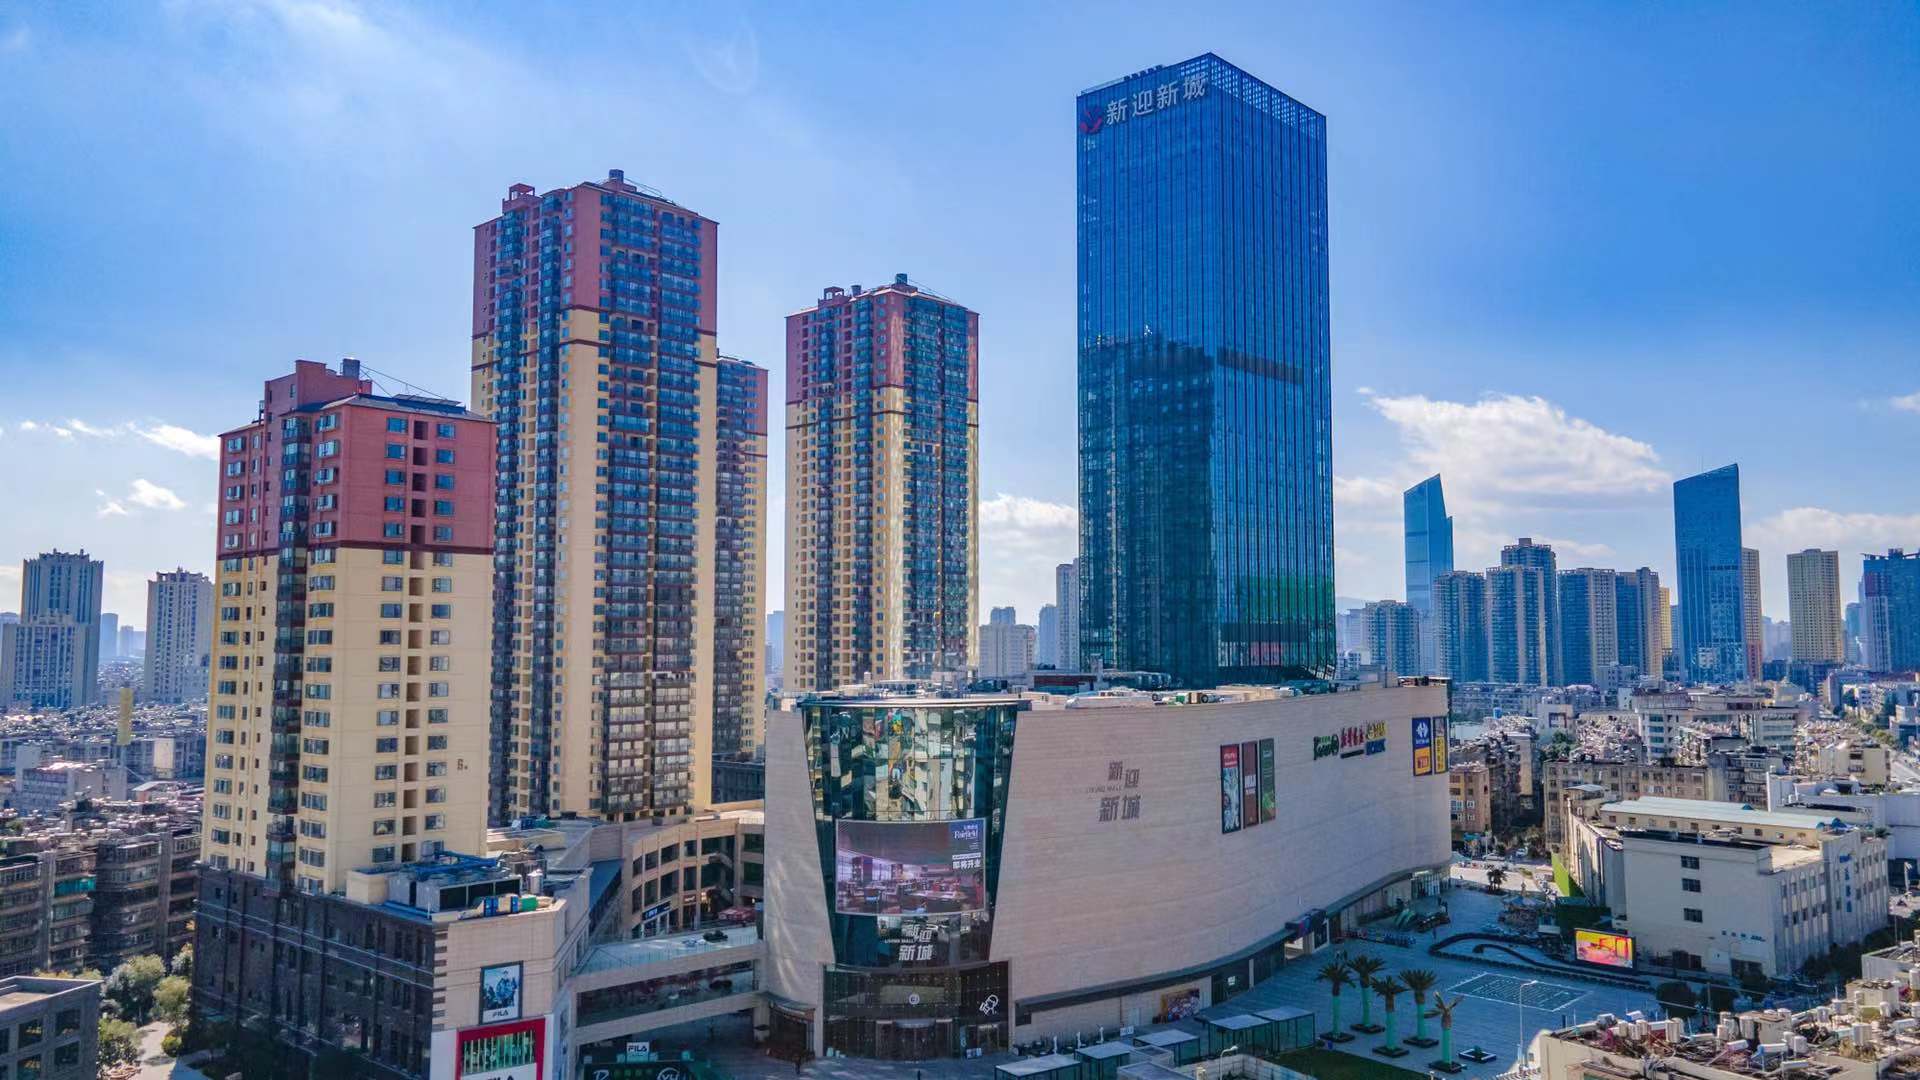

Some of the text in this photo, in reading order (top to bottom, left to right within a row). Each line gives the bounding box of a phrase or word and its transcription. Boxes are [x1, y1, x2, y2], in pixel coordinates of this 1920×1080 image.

[1106, 73, 1206, 126] 新迎新城
[1099, 795, 1141, 821] 新城
[899, 944, 934, 961] 新城
[492, 1009, 509, 1018] FILA
[628, 1045, 648, 1053] FILA
